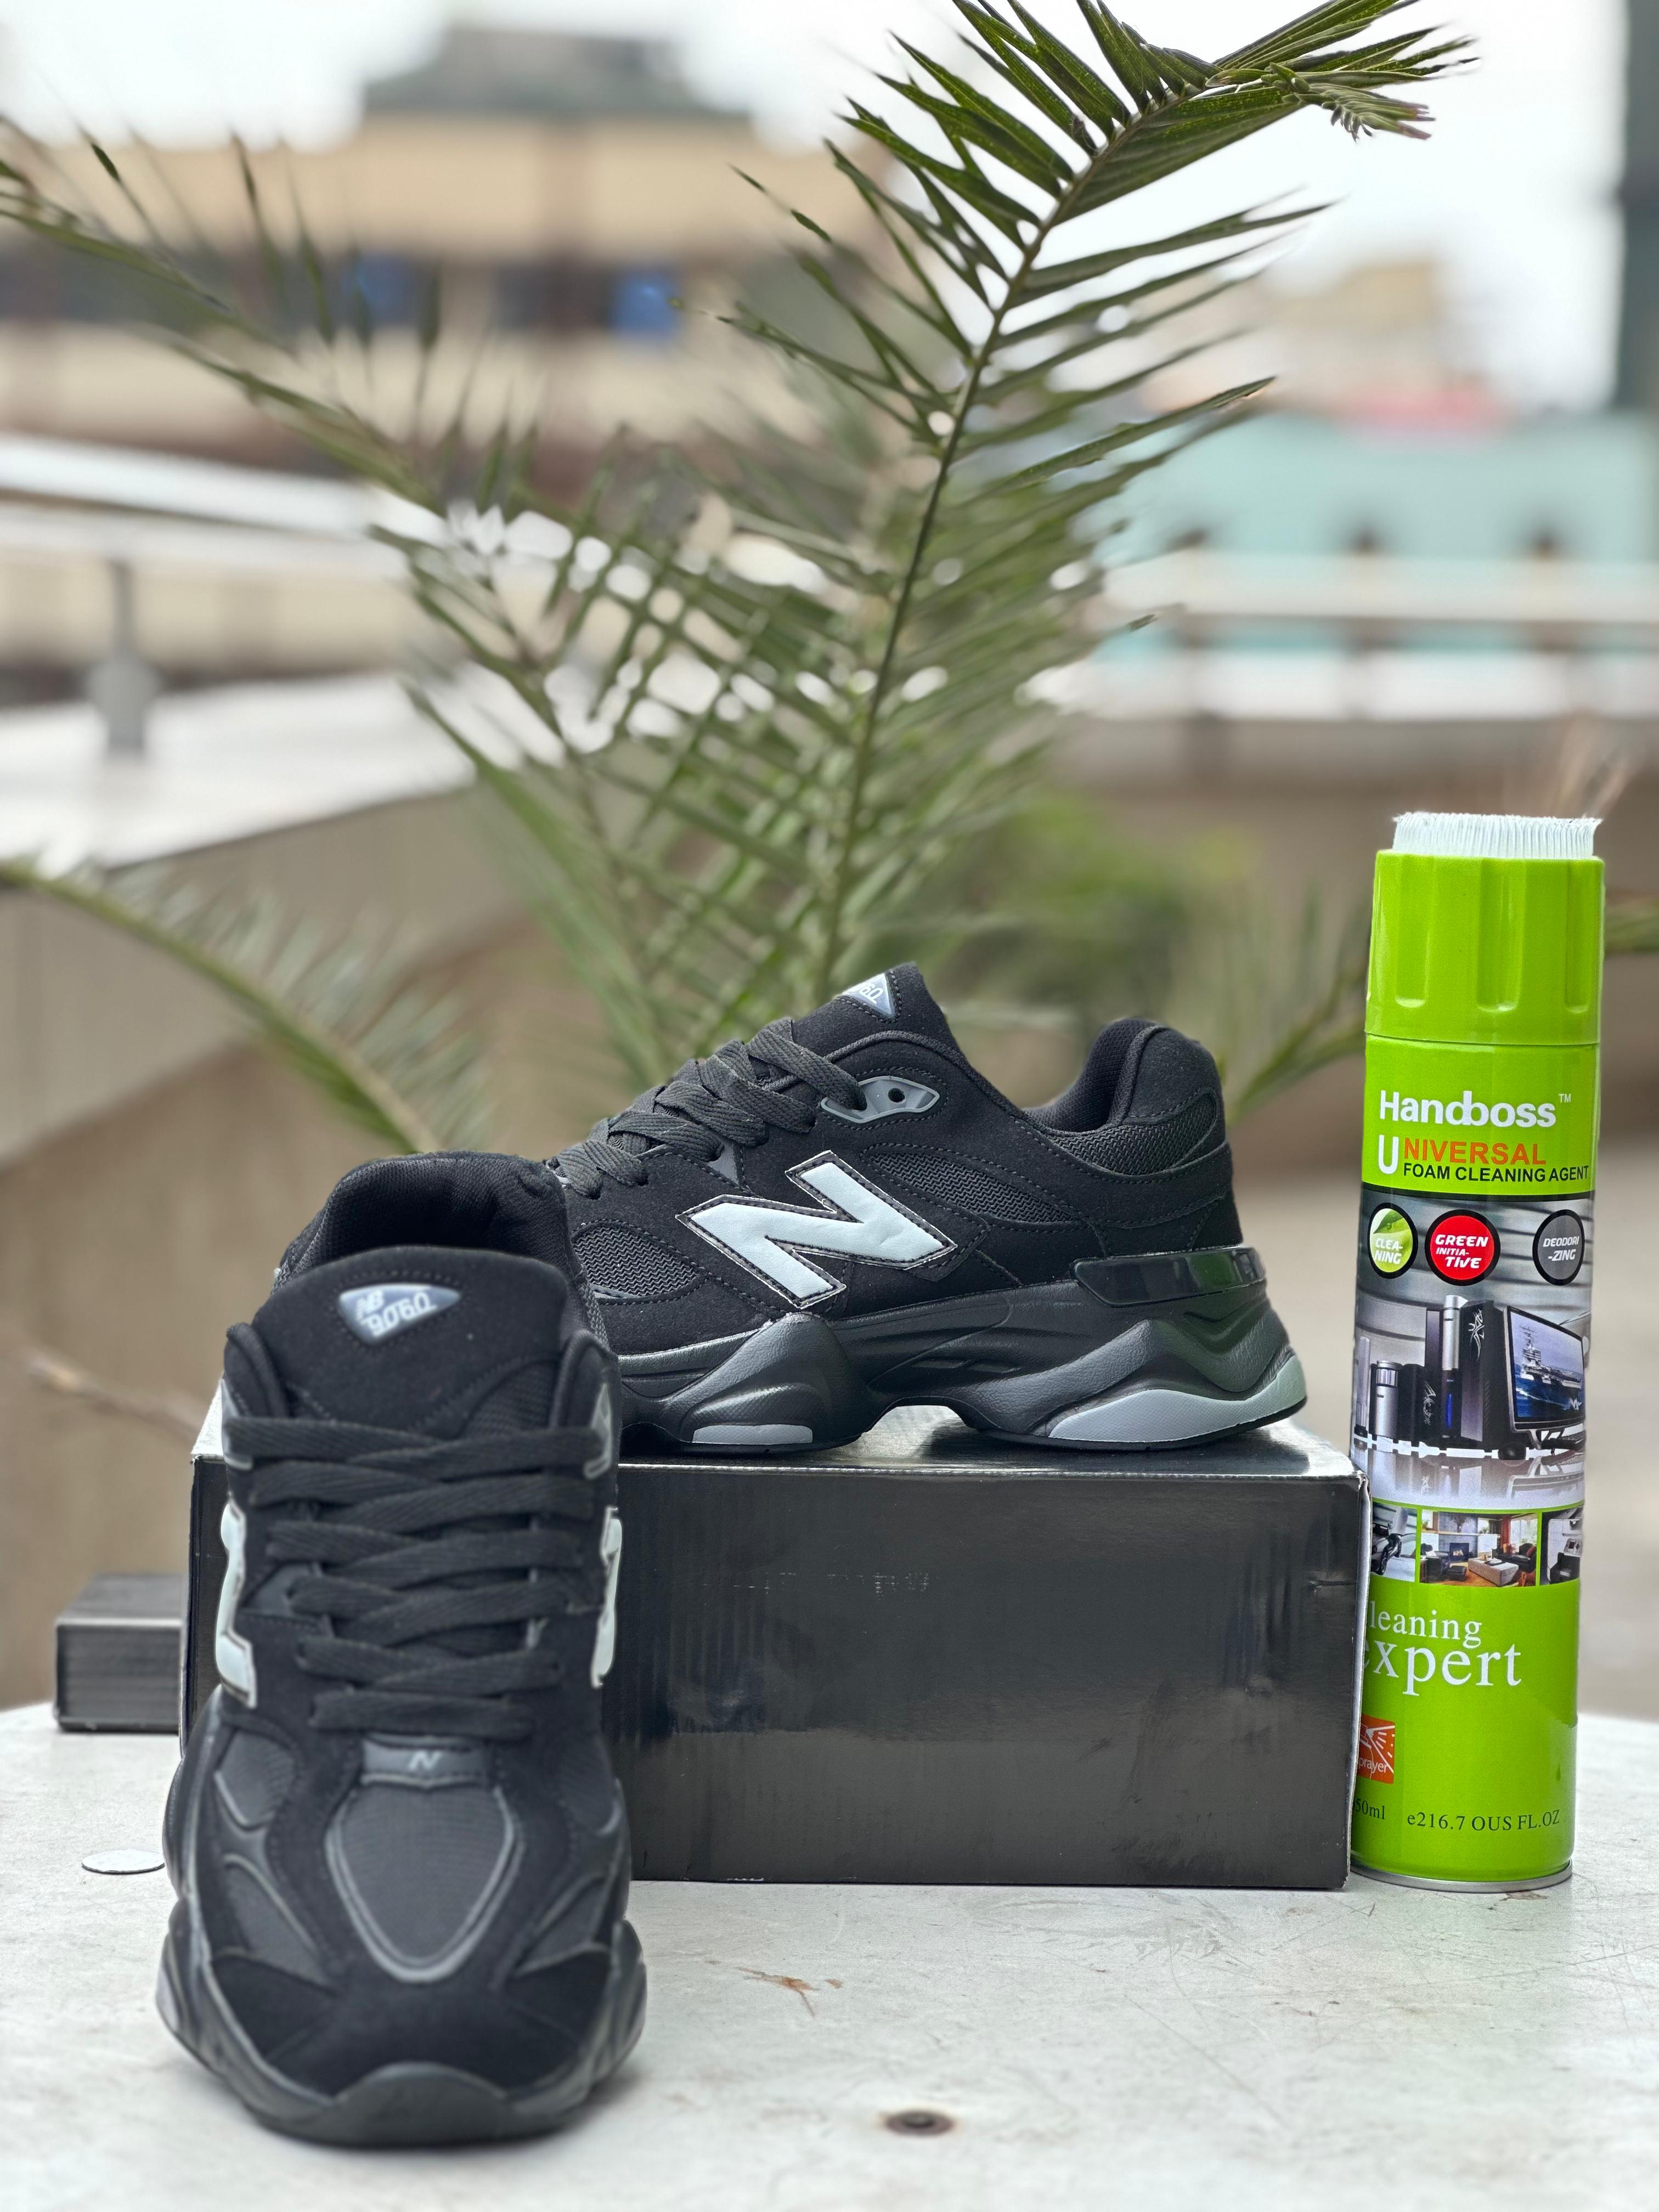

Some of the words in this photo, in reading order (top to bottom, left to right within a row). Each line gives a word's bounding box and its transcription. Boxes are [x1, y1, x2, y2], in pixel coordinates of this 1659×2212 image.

[1379, 1090, 1556, 1127] Handboss
[1403, 1163, 1450, 1180] FOAM
[1455, 1166, 1545, 1182] CLEANING
[1548, 1165, 1589, 1182] AGENT
[1375, 1237, 1403, 1251] CLEA-
[1435, 1234, 1489, 1247] GREEN
[1542, 1235, 1580, 1248] DEODORI
[1374, 1250, 1402, 1265] NING
[1436, 1247, 1469, 1256] INITIA-
[1548, 1249, 1577, 1261] -ZING
[1444, 1256, 1482, 1269] TIVE
[1369, 1600, 1482, 1649] leaning
[1358, 1757, 1387, 1774] prayer
[1352, 1798, 1386, 1820] 50ml
[1471, 1815, 1512, 1831] OUS
